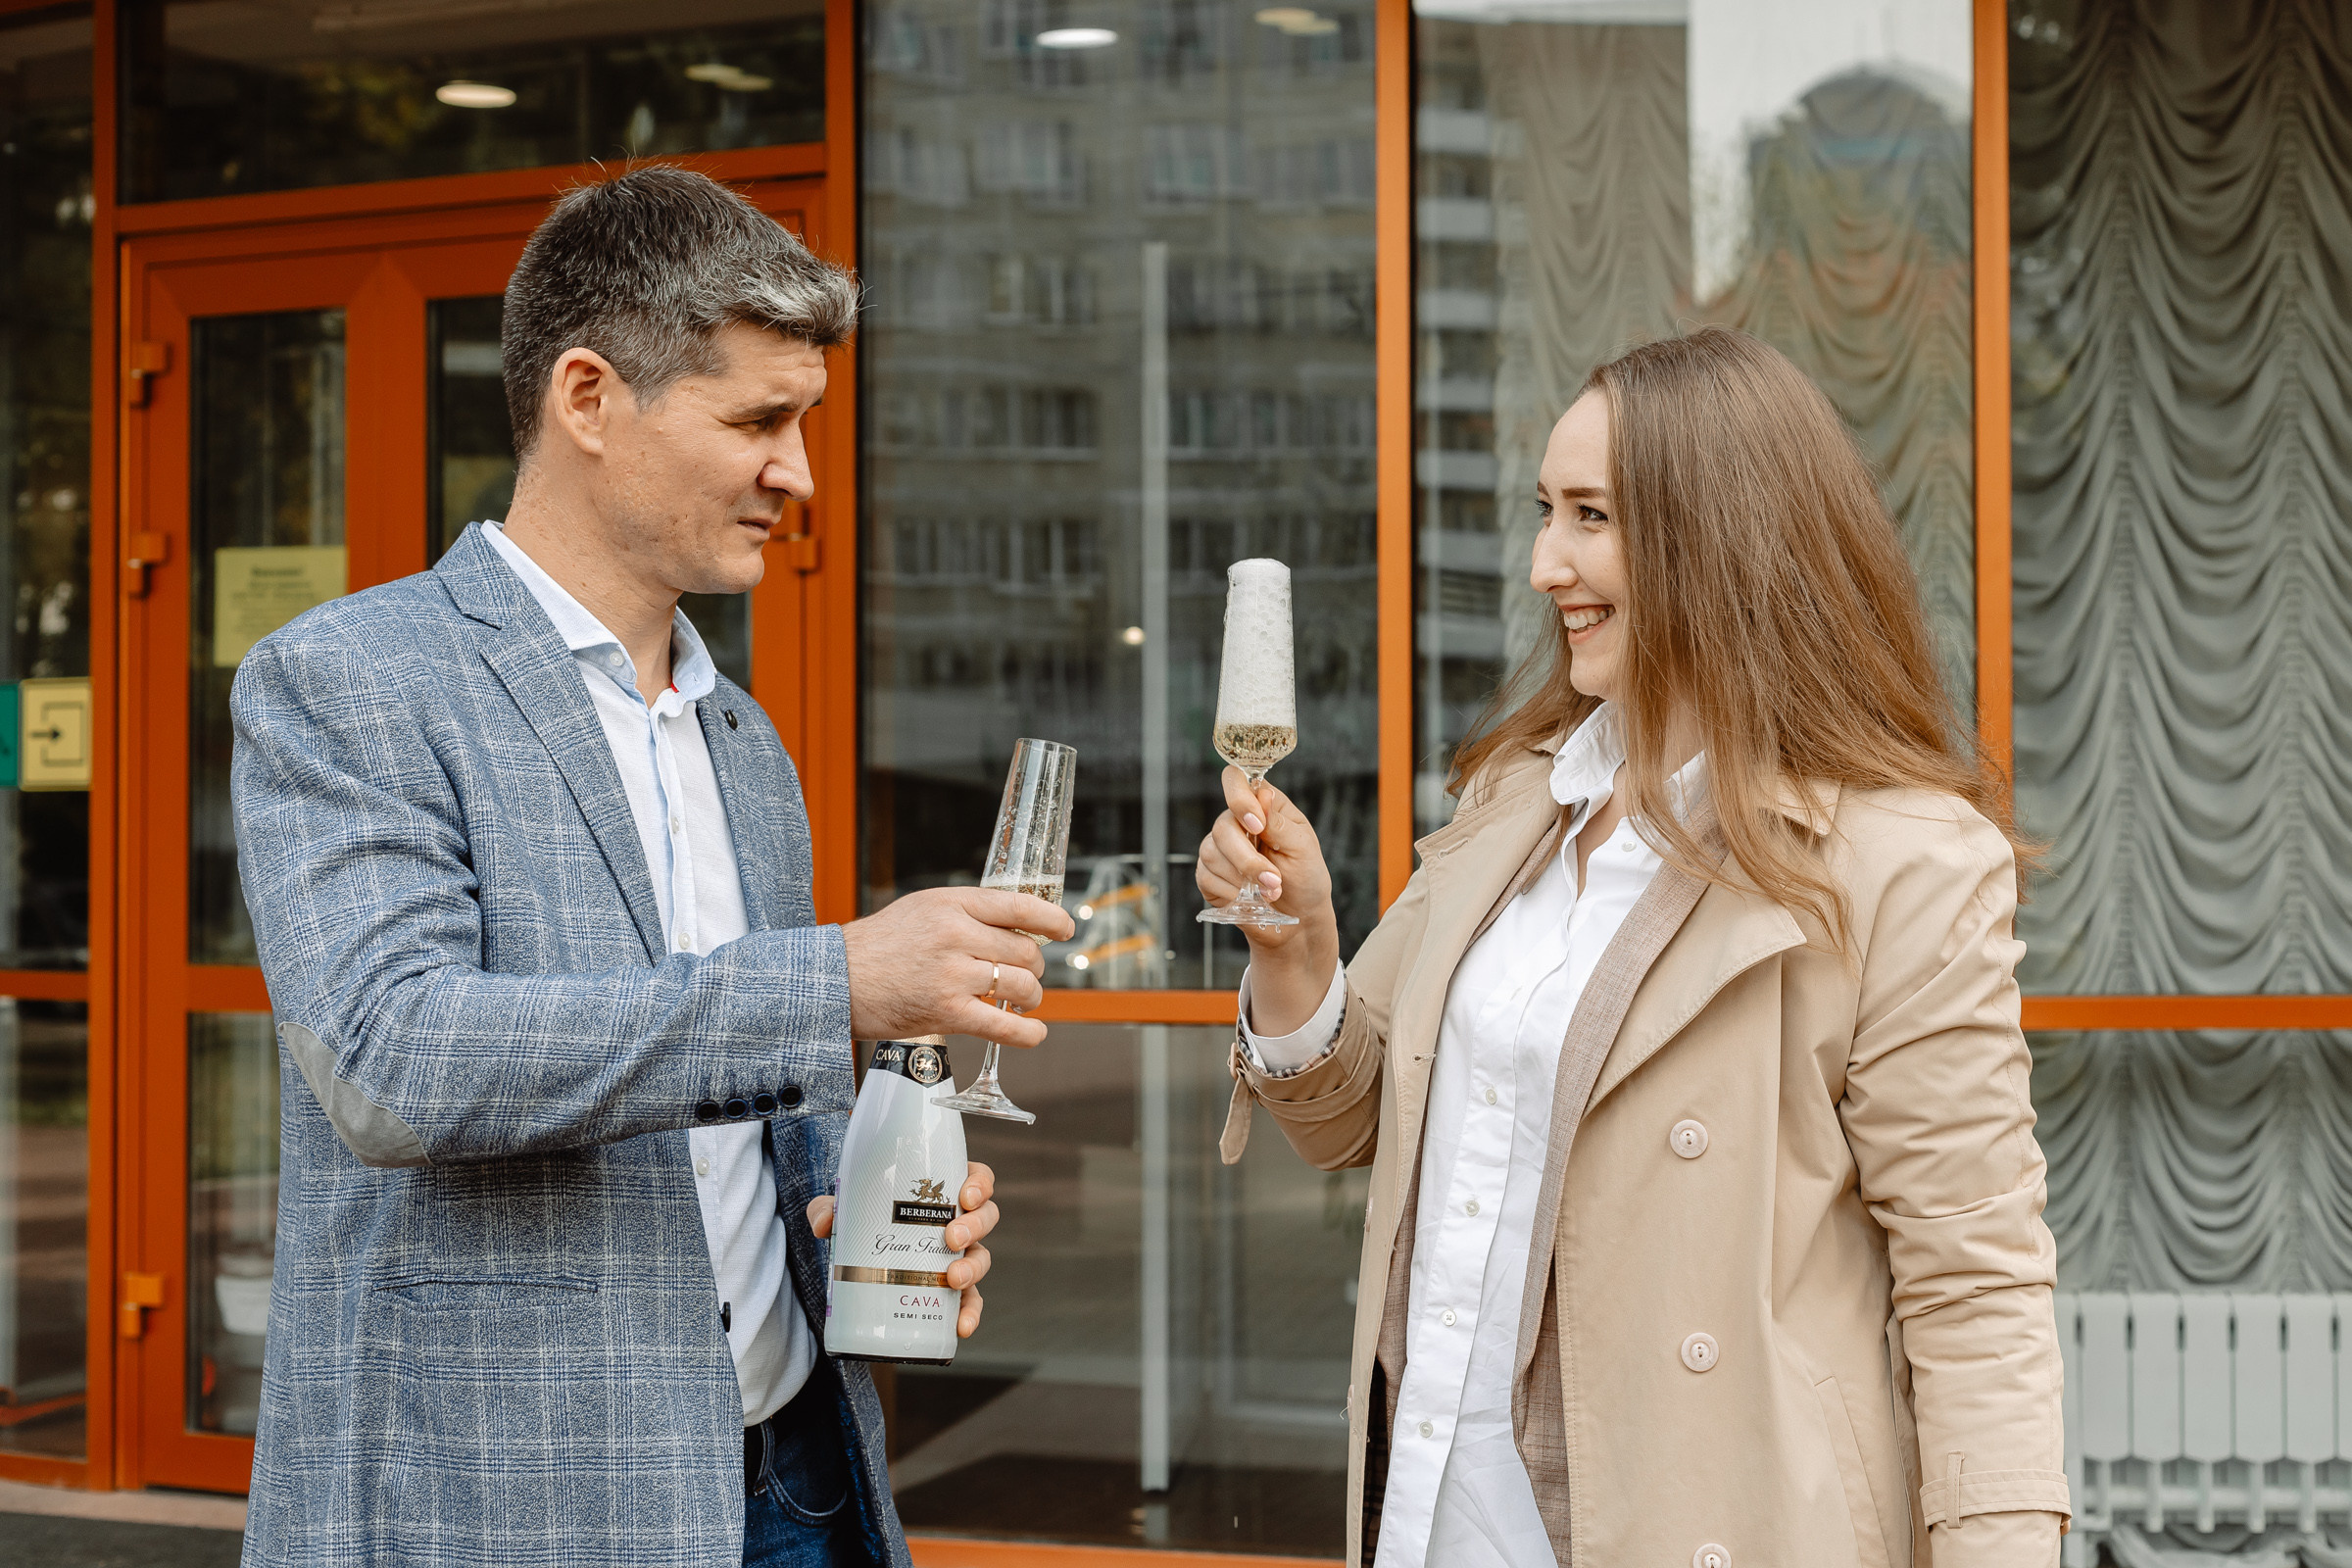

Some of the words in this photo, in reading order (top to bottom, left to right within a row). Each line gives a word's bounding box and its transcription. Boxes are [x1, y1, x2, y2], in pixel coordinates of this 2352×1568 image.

[875, 1049, 901, 1061] CAVA
[900, 1206, 952, 1219] BERBERANA
[871, 1233, 911, 1256] Gran
[900, 1295, 940, 1307] CAVA
